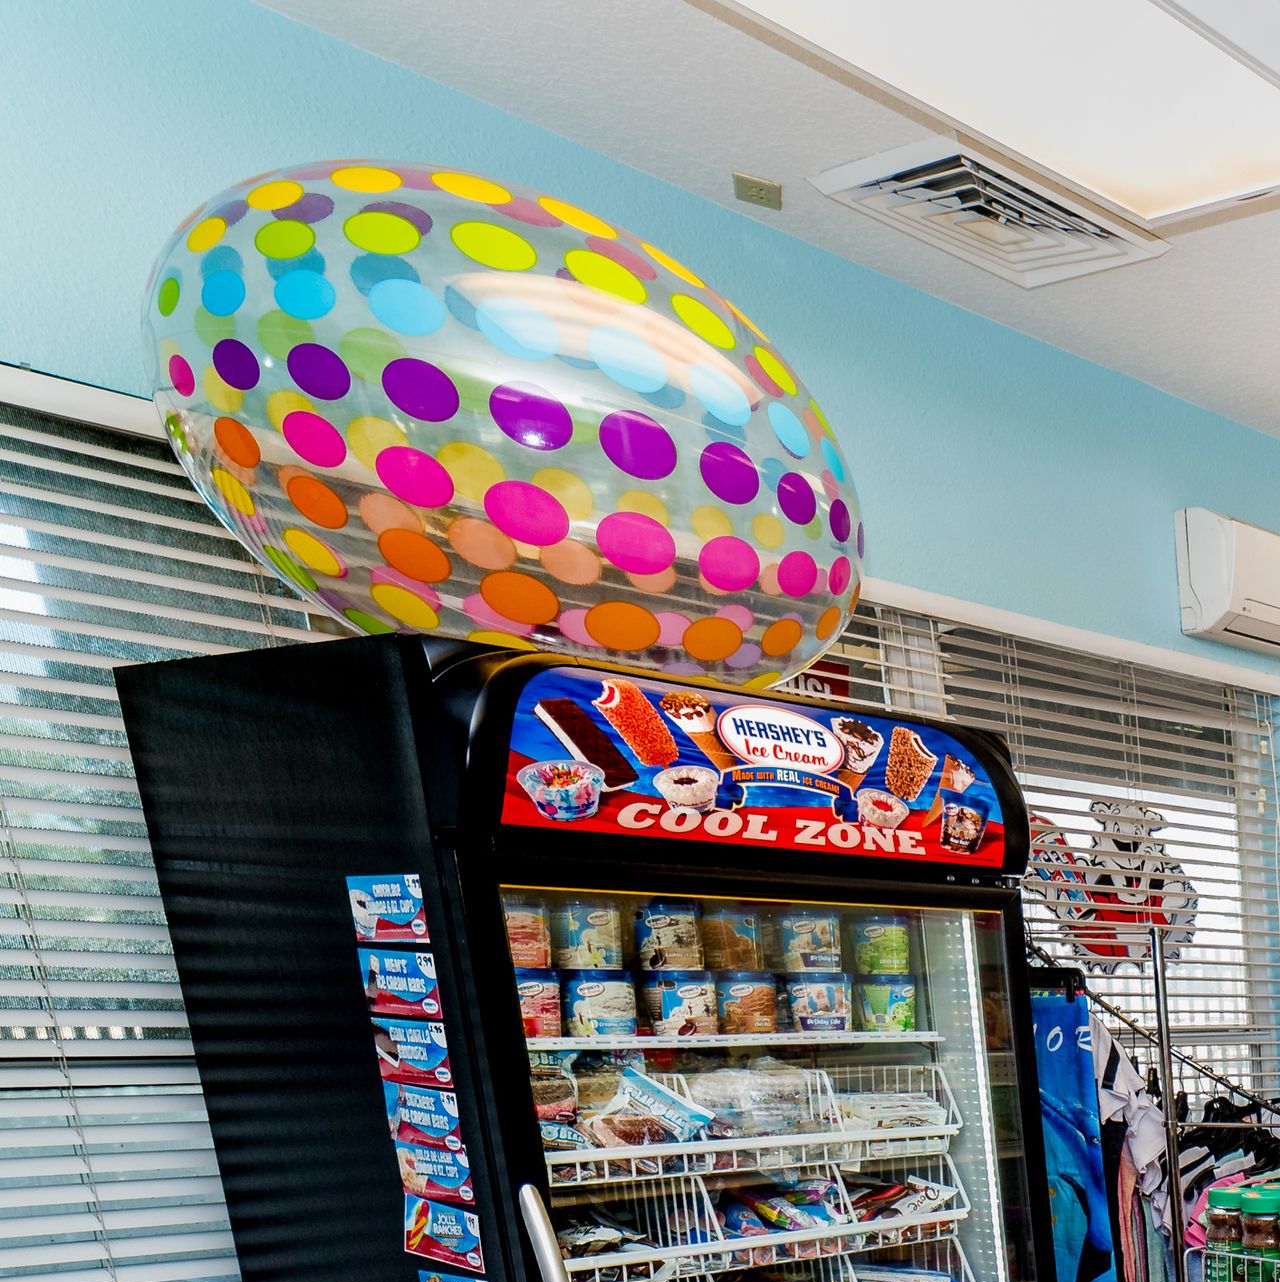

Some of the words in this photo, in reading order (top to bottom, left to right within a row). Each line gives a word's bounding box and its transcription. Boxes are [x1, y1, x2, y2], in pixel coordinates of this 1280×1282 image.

[732, 717, 827, 748] HERSHEY'S
[745, 738, 770, 758] Ice
[773, 744, 829, 767] Cream
[776, 769, 800, 783] REAL
[617, 802, 780, 843] COOL
[795, 819, 927, 857] ZONE
[623, 1086, 656, 1107] POLAR
[664, 1109, 690, 1130] BEAR
[433, 1223, 464, 1238] RANCHER
[437, 1213, 456, 1225] JOLLY
